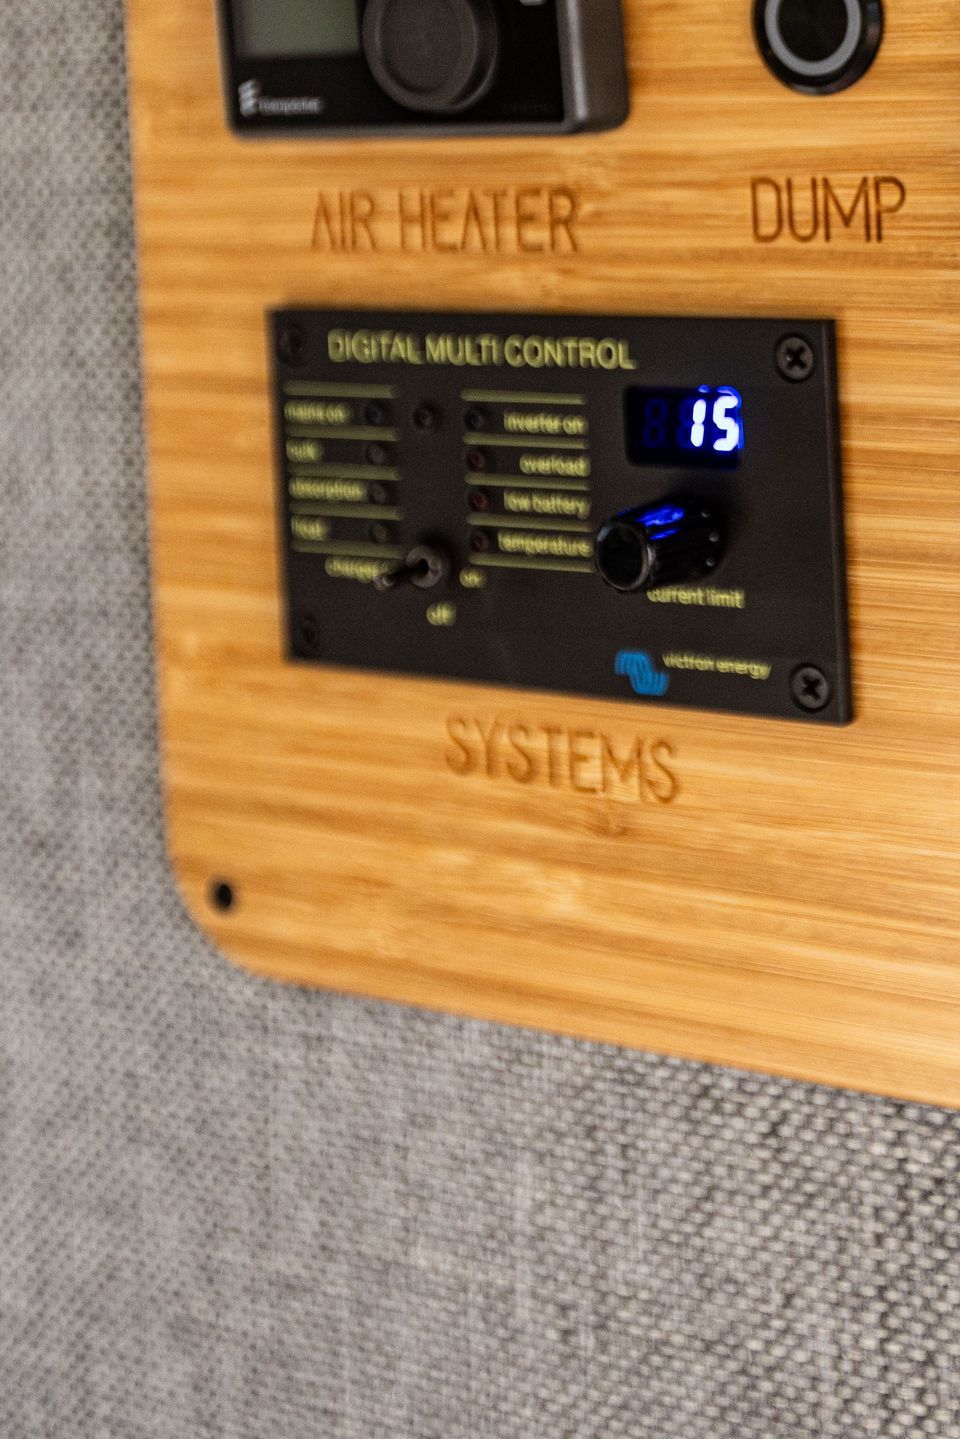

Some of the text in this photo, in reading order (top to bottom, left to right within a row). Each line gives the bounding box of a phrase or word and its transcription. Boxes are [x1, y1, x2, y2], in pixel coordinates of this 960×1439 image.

[309, 187, 580, 254] AIR HEATER
[749, 175, 906, 245] DUMP
[327, 328, 637, 370] DIGITAL MULTI CONTROL
[690, 389, 742, 452] 15
[647, 585, 745, 608] current limit
[715, 659, 772, 680] energy
[444, 713, 680, 805] SYSTEMS
